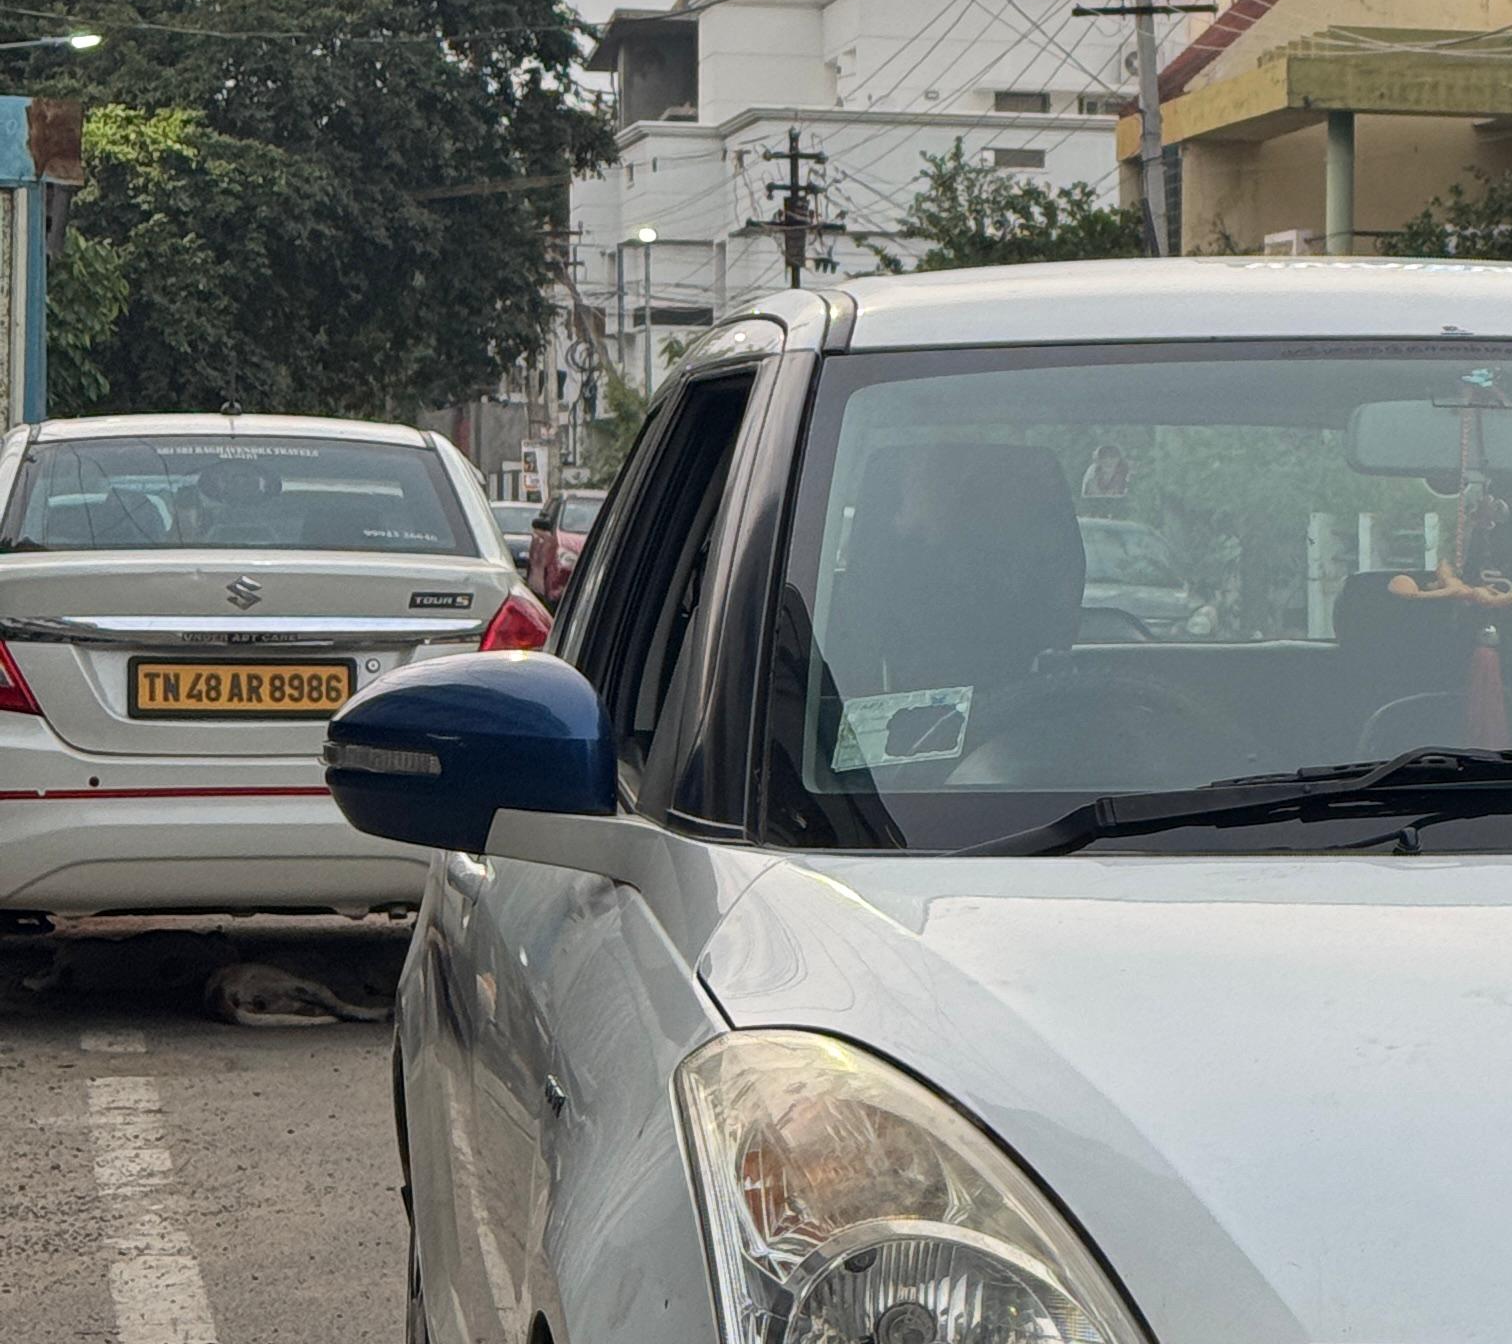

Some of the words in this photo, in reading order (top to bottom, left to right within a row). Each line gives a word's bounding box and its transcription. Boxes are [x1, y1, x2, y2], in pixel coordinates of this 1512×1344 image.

[415, 596, 452, 605] TOUR
[455, 595, 470, 607] S
[143, 672, 180, 702] TN
[186, 672, 222, 702] 48
[227, 672, 263, 703] AR
[269, 672, 343, 703] 8986
